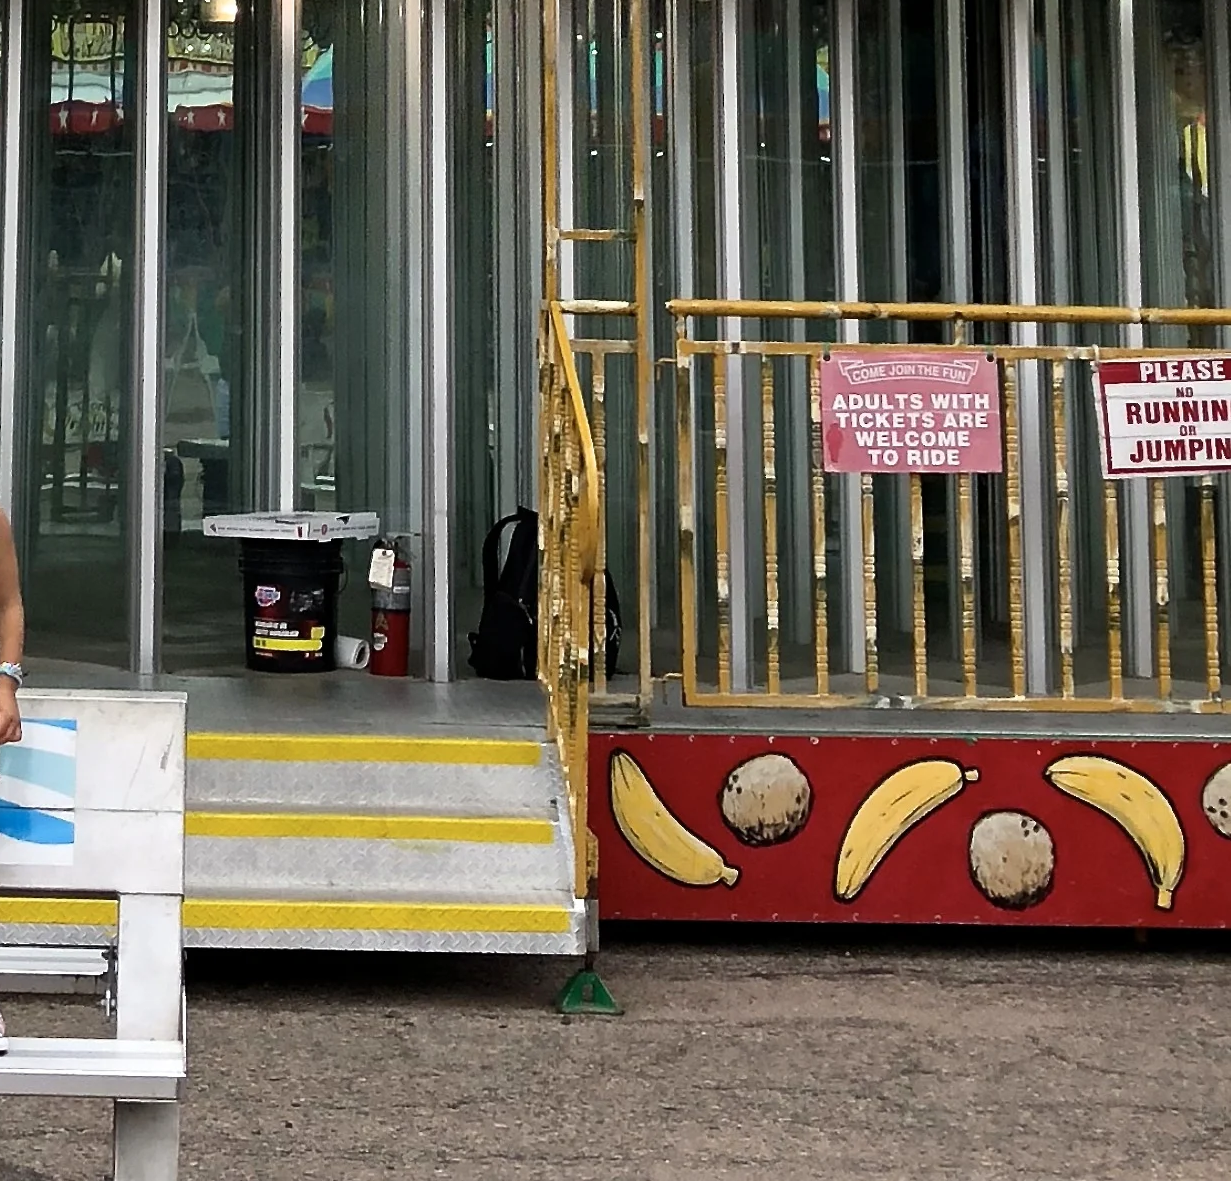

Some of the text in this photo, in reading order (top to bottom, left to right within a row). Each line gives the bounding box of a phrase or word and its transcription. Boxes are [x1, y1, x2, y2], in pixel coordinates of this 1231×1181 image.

[852, 365, 966, 381] COME JOIN THE FUN
[1139, 360, 1226, 382] PLEASE
[1175, 387, 1194, 398] NO
[832, 393, 990, 410] ADULTS WITH
[835, 412, 989, 429] TICKETS ARE
[1125, 399, 1231, 425] RUNNIN
[854, 431, 971, 447] WELCOME
[1179, 425, 1197, 436] OR
[868, 449, 961, 466] TO RIDE
[1129, 437, 1231, 463] JUMPIN
